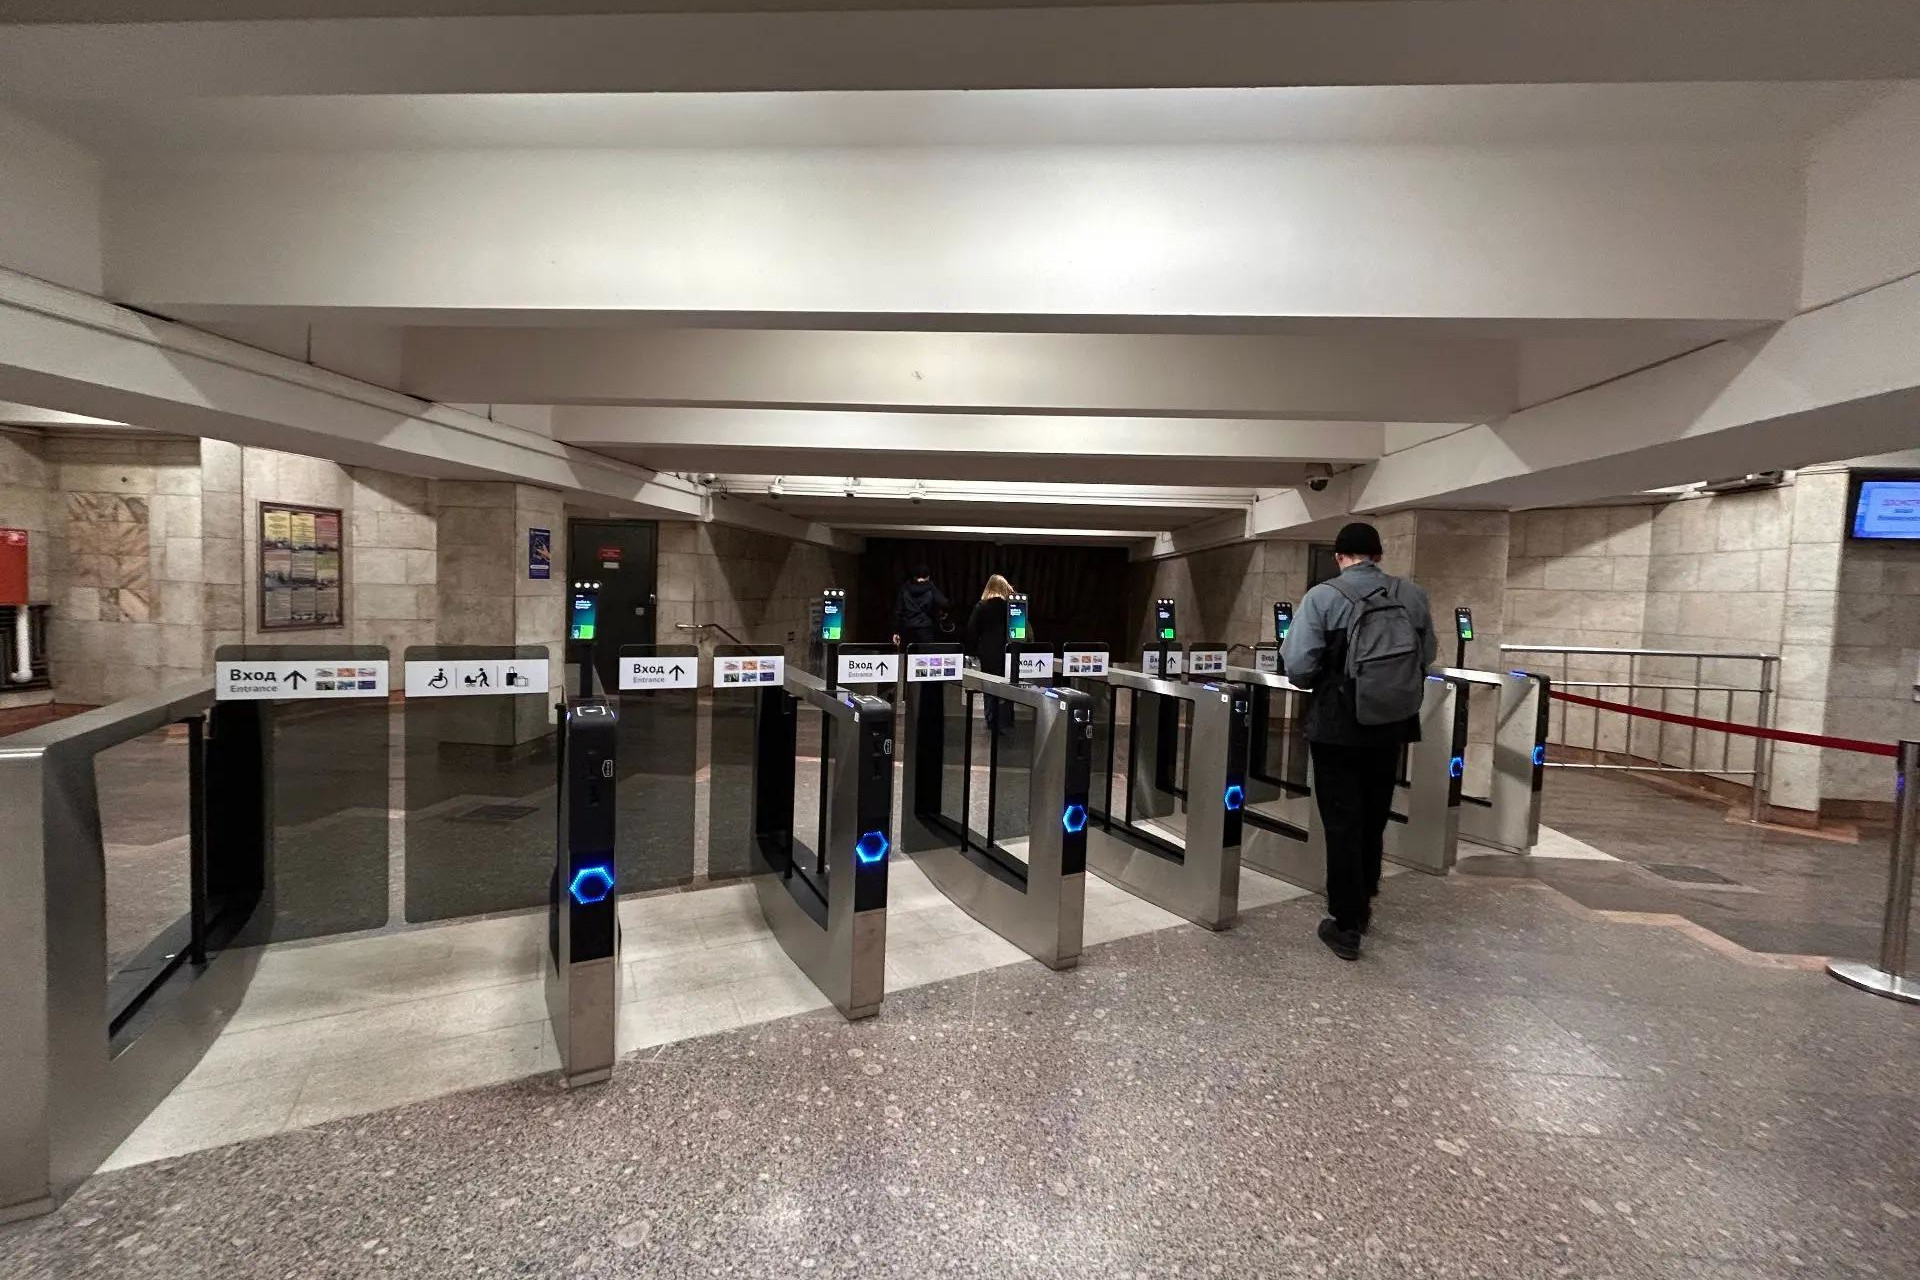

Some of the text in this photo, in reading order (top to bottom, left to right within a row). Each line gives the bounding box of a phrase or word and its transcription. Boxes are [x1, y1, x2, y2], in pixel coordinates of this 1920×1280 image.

[633, 663, 665, 675] Вход
[848, 660, 873, 670] Вход
[229, 668, 277, 682] Вход
[633, 676, 665, 684] Entrance
[229, 684, 278, 693] Entrance
